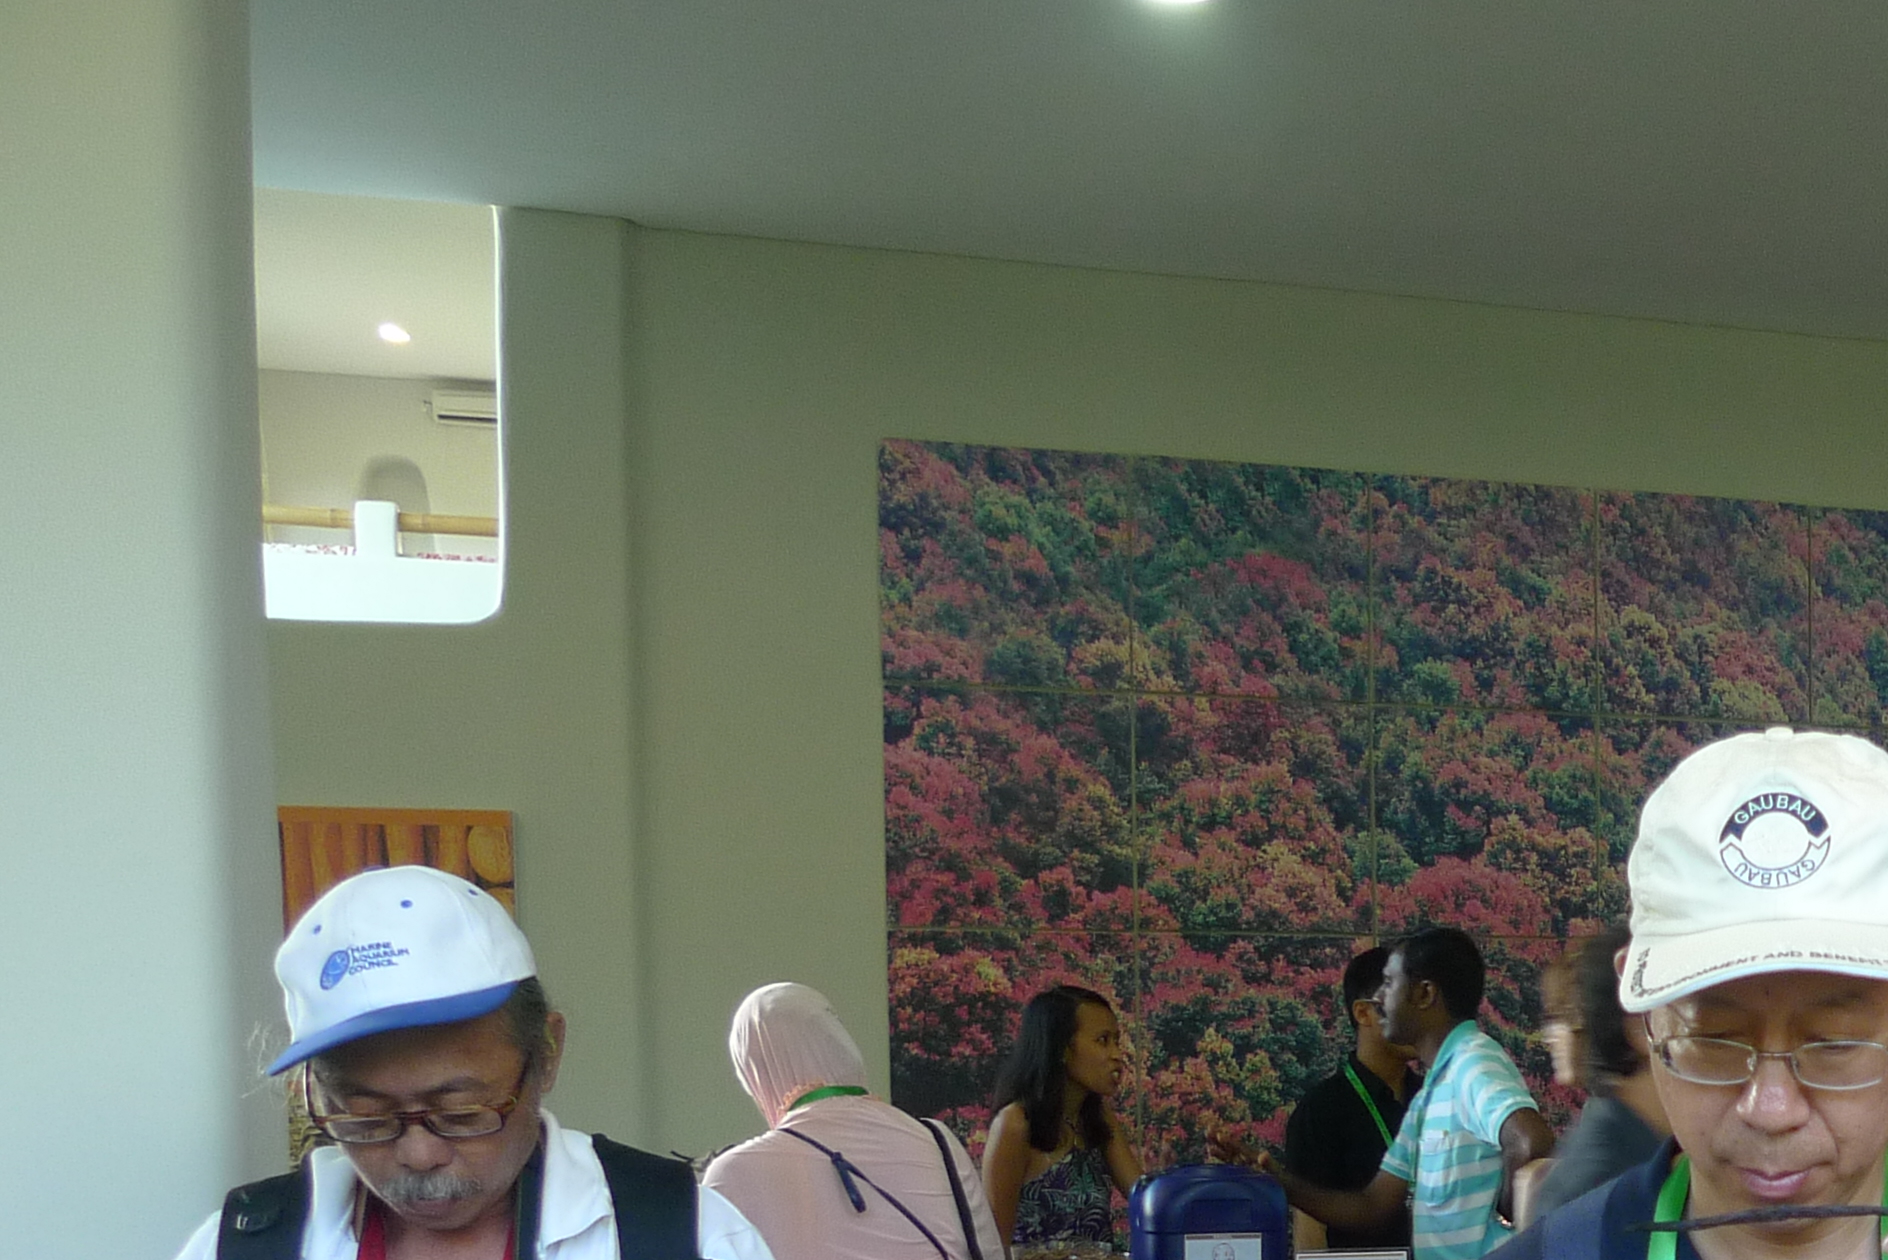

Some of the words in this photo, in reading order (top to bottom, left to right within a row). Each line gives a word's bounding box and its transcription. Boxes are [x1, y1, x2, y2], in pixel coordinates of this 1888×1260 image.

[1734, 795, 1816, 824] GAUBAU
[1734, 858, 1816, 886] GAUBAU
[1763, 951, 1803, 959] AND
[349, 959, 399, 975] COUNCIL
